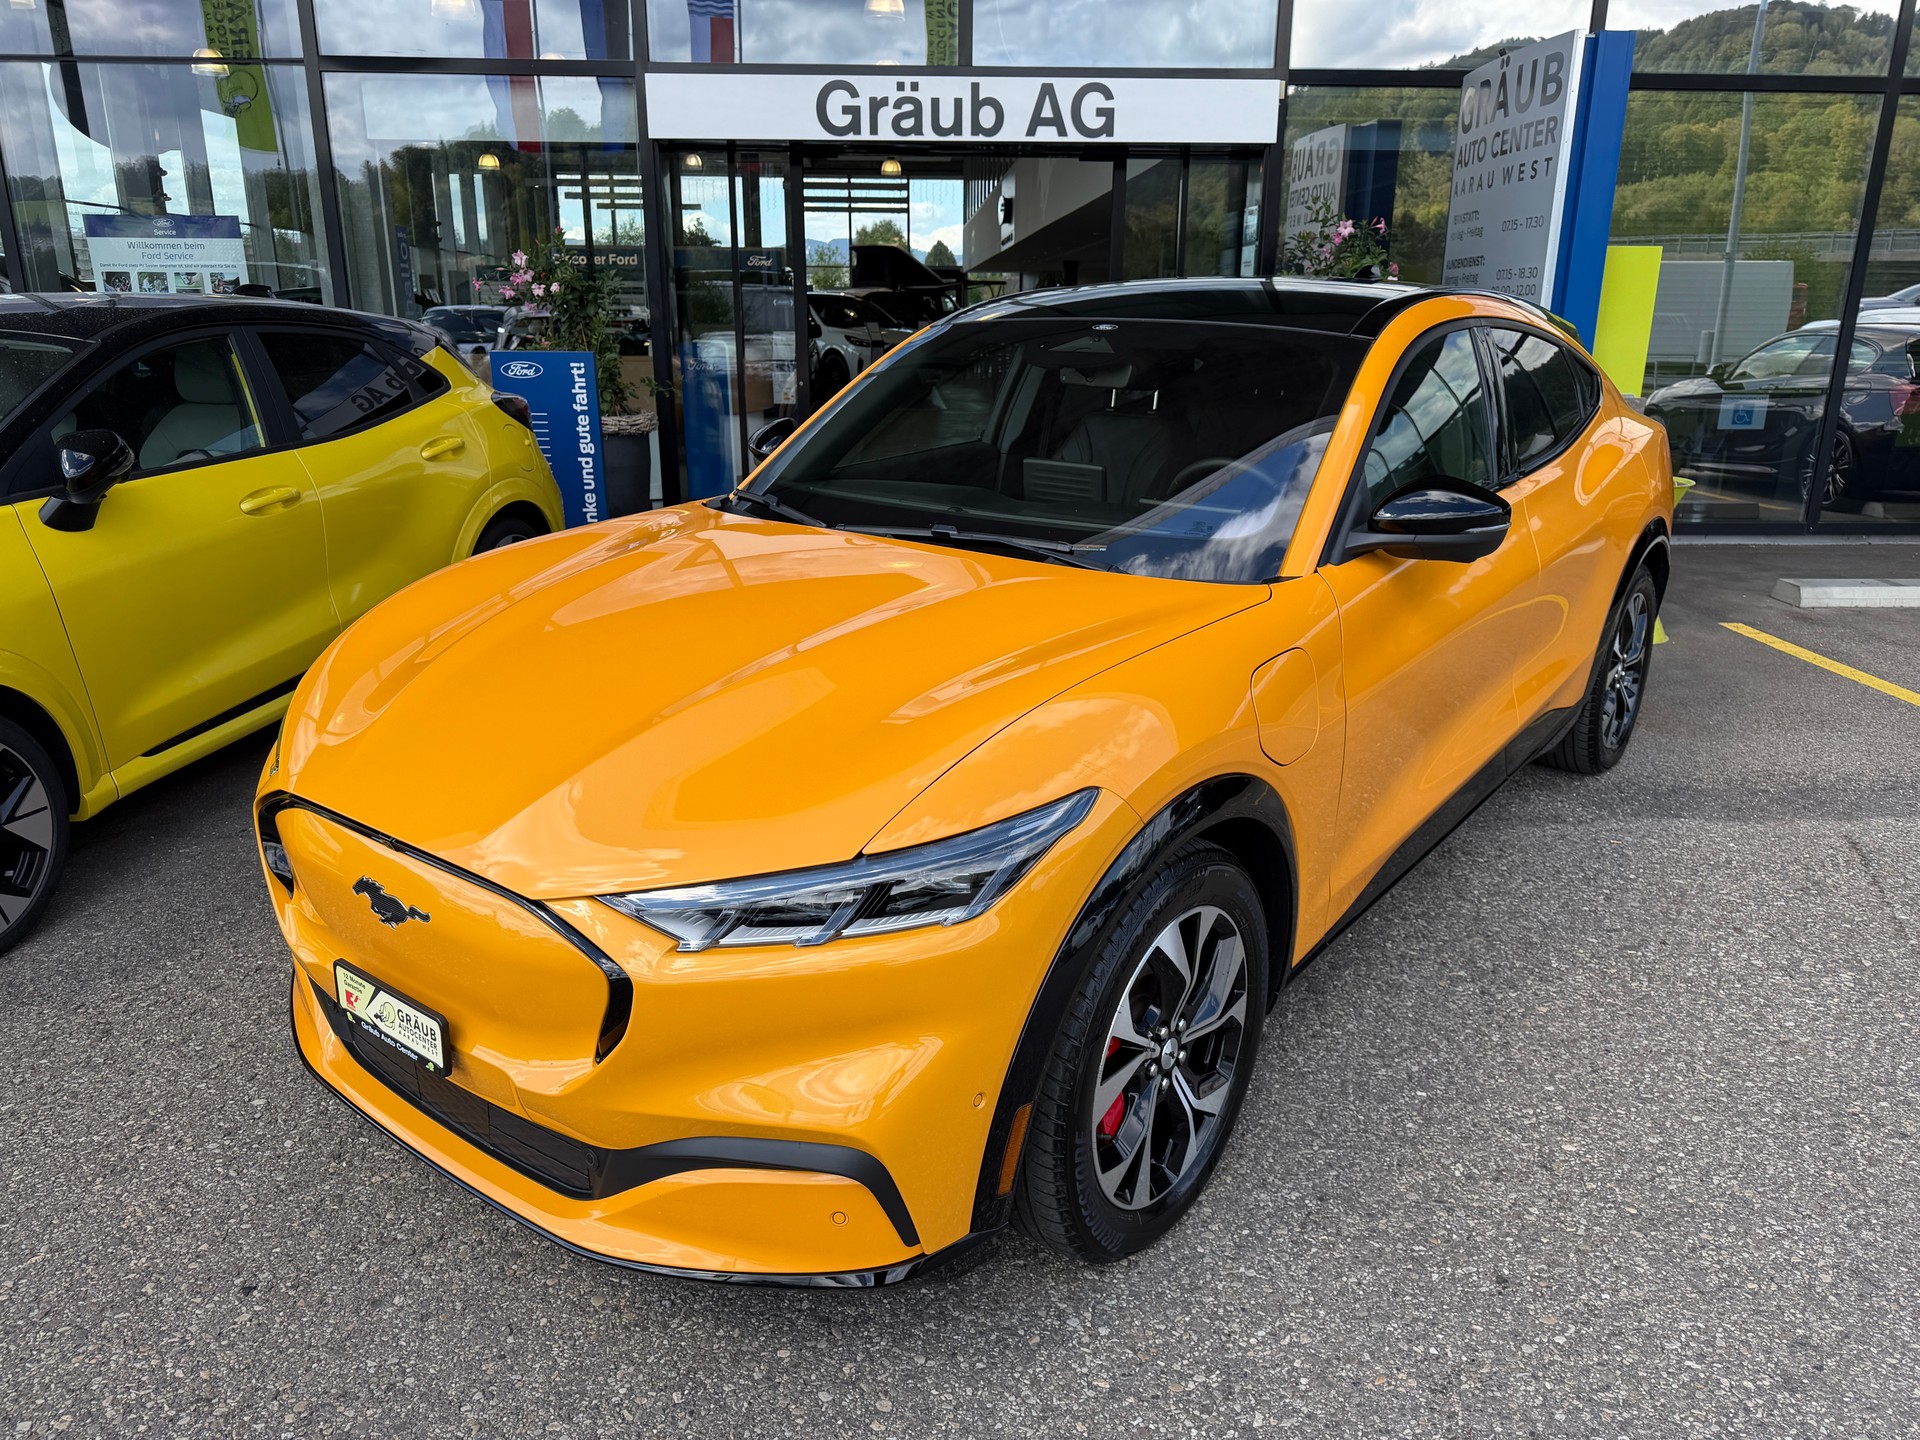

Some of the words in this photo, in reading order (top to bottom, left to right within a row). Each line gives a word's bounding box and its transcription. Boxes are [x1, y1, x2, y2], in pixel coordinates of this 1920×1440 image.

[1461, 51, 1565, 135] GRÄUB
[816, 79, 1005, 137] Gräub
[1025, 82, 1115, 139] AG
[1456, 136, 1487, 170] AUTO
[1491, 115, 1559, 159] CENTER
[1452, 170, 1495, 198] AARAU
[1502, 156, 1553, 185] WEST
[1525, 215, 1544, 229] 17.30
[127, 241, 182, 250] Willkommen
[184, 241, 205, 250] beim
[141, 252, 161, 260] Ford
[164, 252, 194, 260] Service
[608, 253, 638, 265] Ford
[747, 255, 773, 267] Ford
[1518, 266, 1538, 279] 18.30
[1516, 284, 1537, 297] 12.00
[506, 362, 537, 376] Ford
[569, 362, 589, 413] fahrt!
[576, 415, 595, 455] gute
[578, 457, 595, 490] und
[583, 493, 598, 523] nke
[397, 1008, 437, 1042] GRÄUB
[398, 1023, 438, 1051] AUTOCENTER
[381, 1033, 396, 1048] Auto
[396, 1043, 418, 1061] Center
[398, 1030, 420, 1046] AARAU
[422, 1045, 439, 1057] WEST
